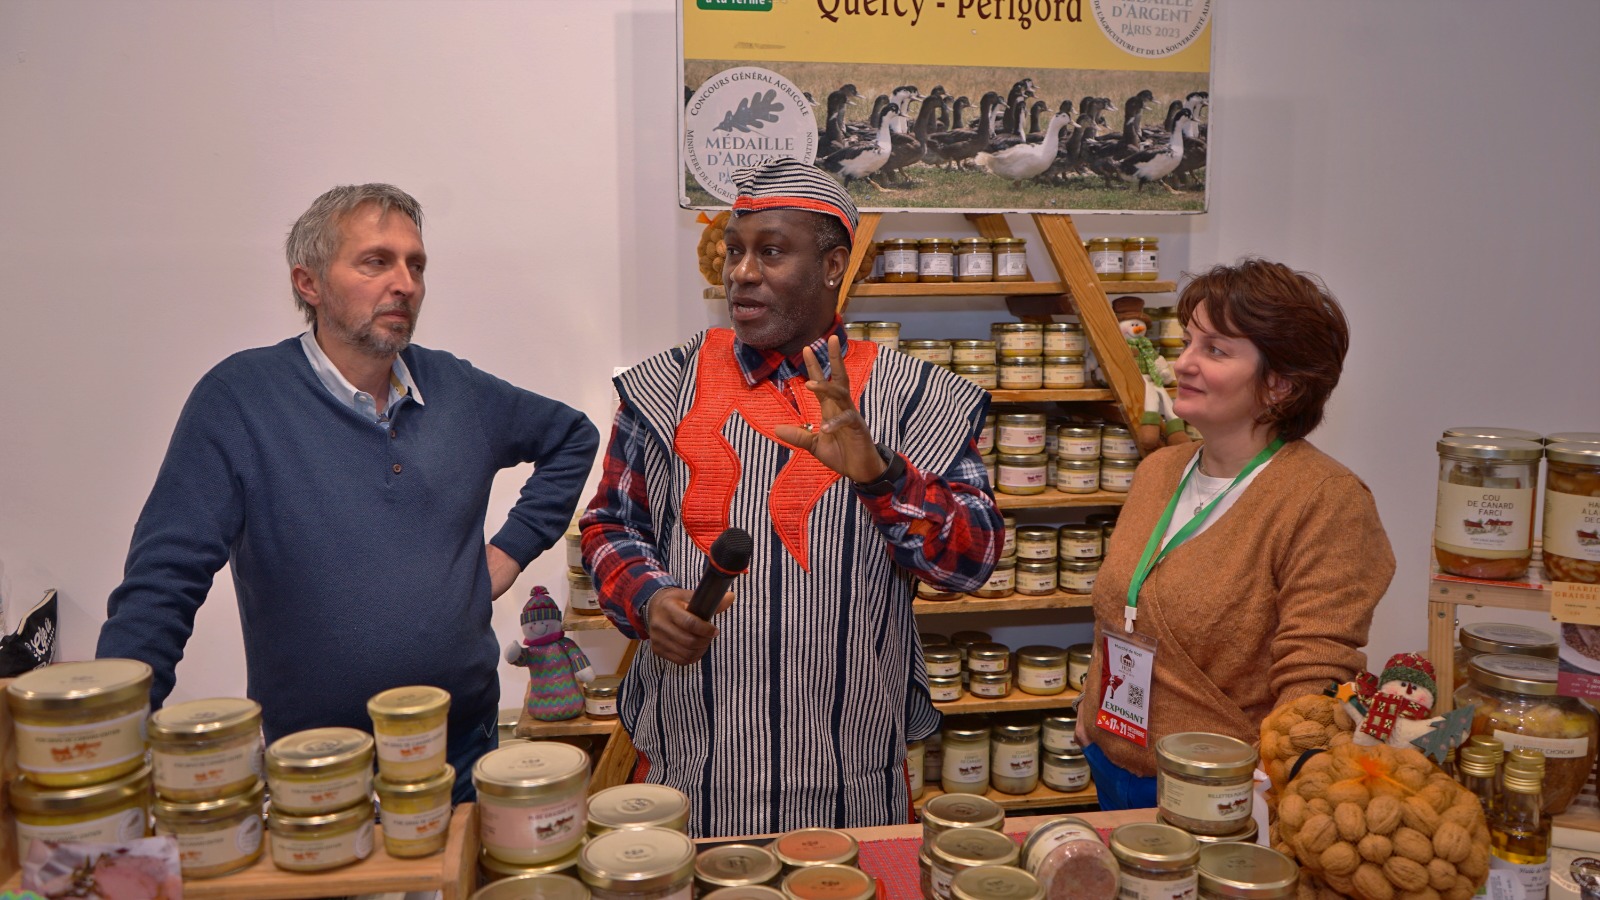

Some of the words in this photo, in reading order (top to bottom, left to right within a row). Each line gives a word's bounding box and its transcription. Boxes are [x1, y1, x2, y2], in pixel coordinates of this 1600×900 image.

[817, 0, 924, 26] Quercy
[1112, 4, 1191, 23] D'ARGENT
[1121, 20, 1152, 36] PARIS
[1155, 27, 1180, 38] 2023
[690, 77, 730, 116] CONCOURS
[731, 71, 773, 83] GÉNÉRAL
[773, 80, 810, 117] AGRICOLE
[705, 133, 794, 151] MÉDAILLE
[699, 171, 709, 182] DE
[1481, 501, 1514, 510] CANARD
[1482, 494, 1500, 502] COU
[1478, 508, 1502, 516] FARCI
[1105, 701, 1144, 724] EXPOSANT
